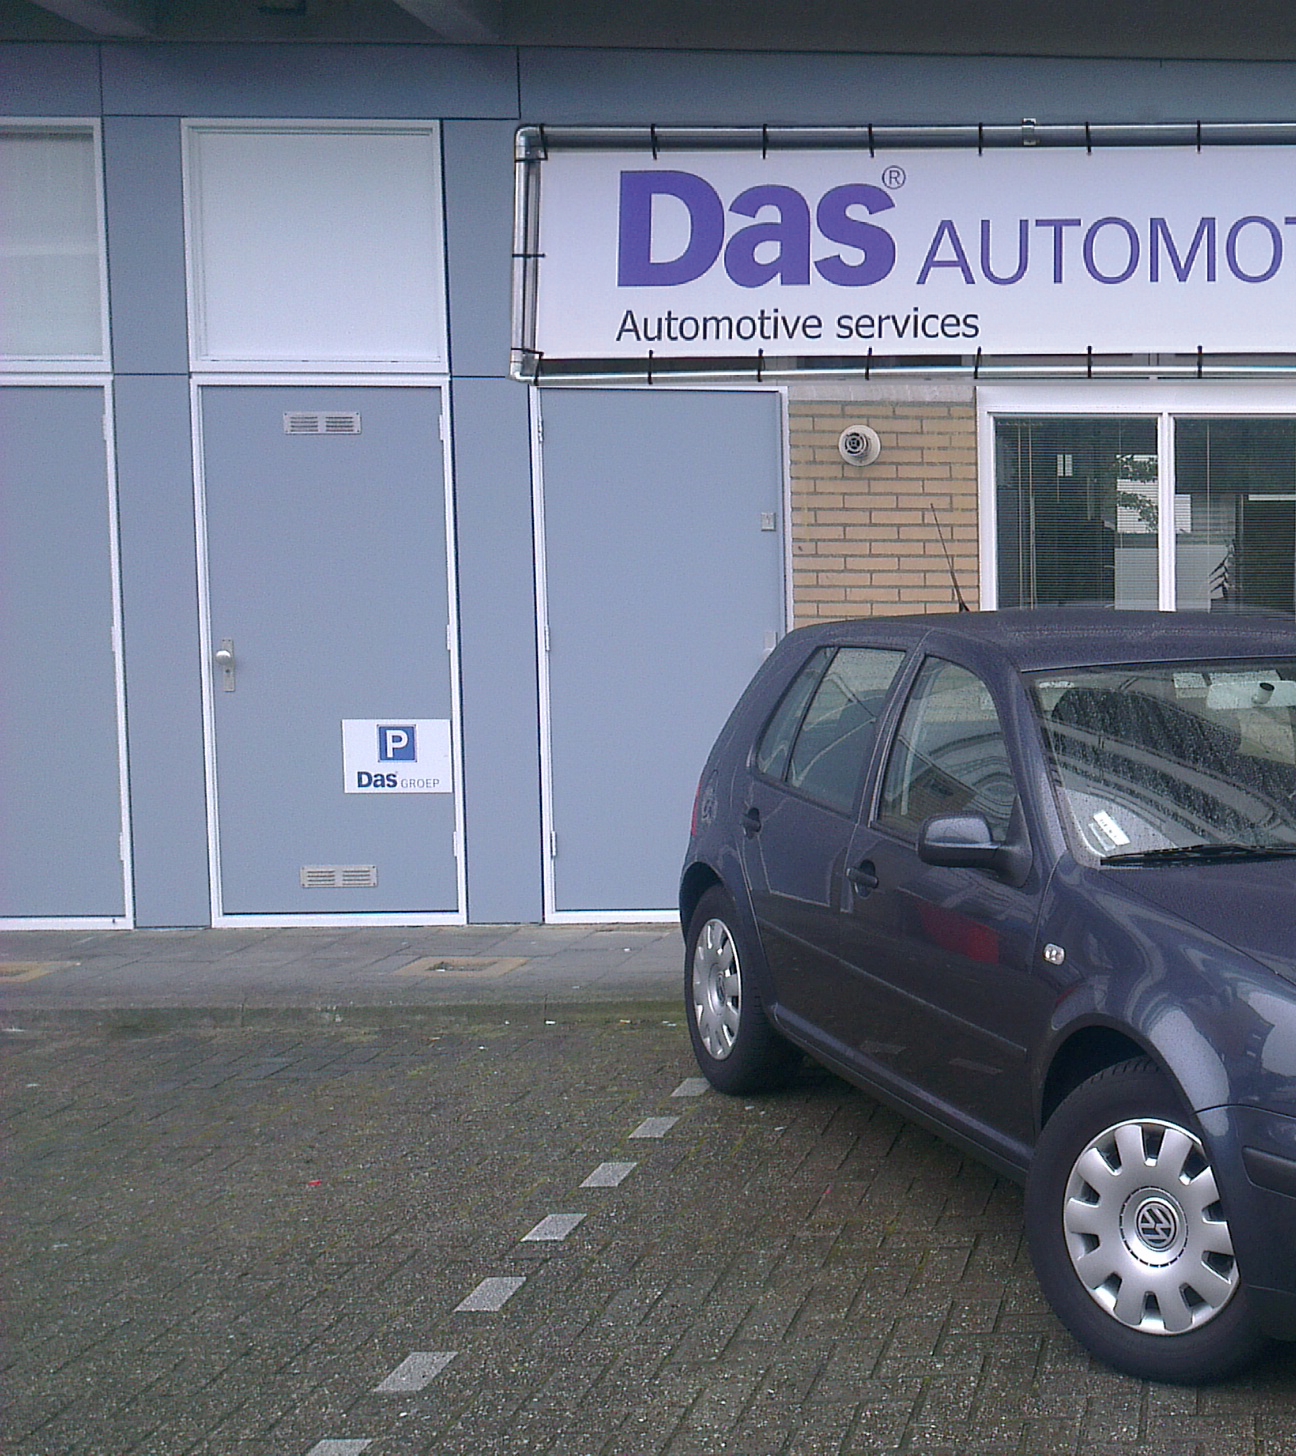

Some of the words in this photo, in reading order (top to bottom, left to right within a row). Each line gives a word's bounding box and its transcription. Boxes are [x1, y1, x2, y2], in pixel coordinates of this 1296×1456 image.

[616, 308, 823, 342] Automotive
[836, 308, 980, 339] services
[385, 729, 409, 758] P
[357, 771, 397, 788] Das
[401, 779, 440, 788] GROEP
